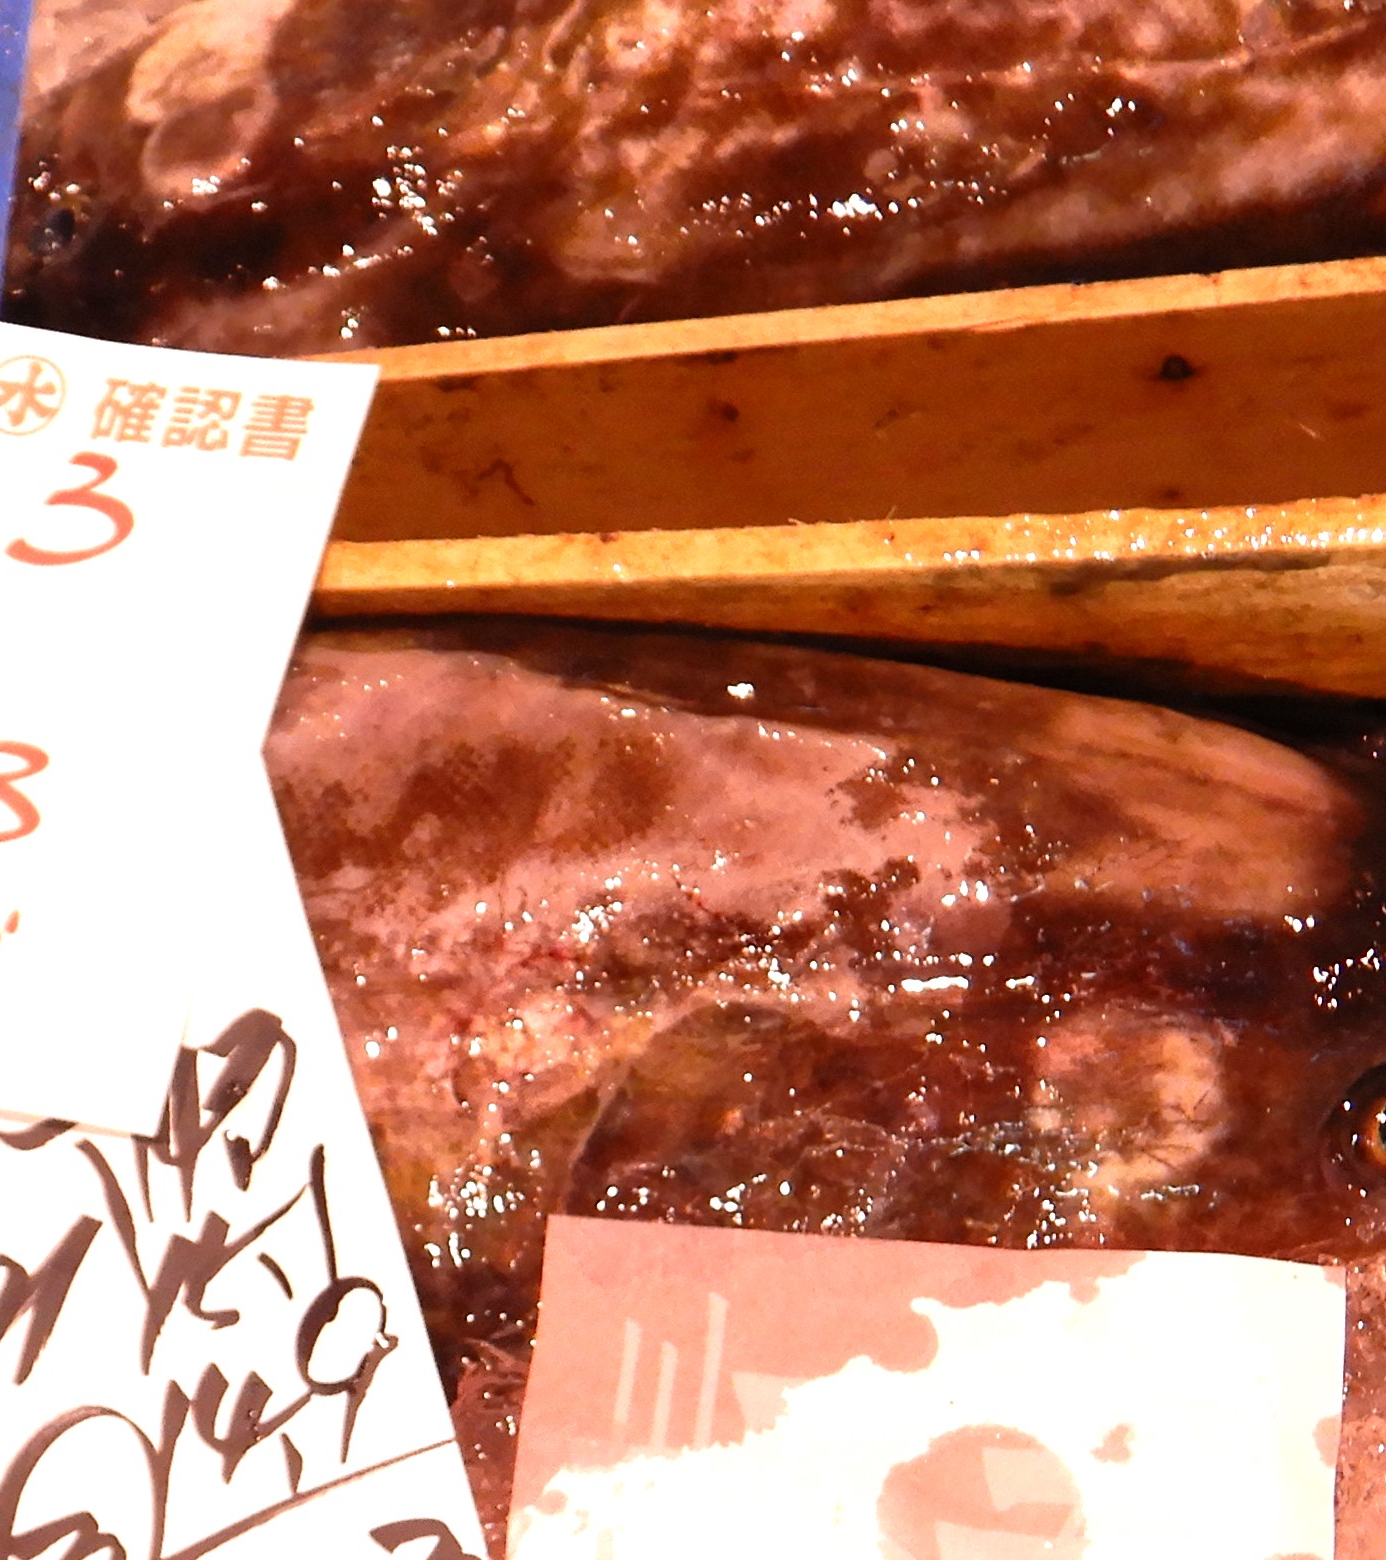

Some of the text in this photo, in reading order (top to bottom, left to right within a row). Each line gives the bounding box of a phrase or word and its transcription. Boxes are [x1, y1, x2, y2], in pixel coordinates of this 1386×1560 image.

[89, 375, 316, 461] 確認書
[4, 450, 137, 567] 3
